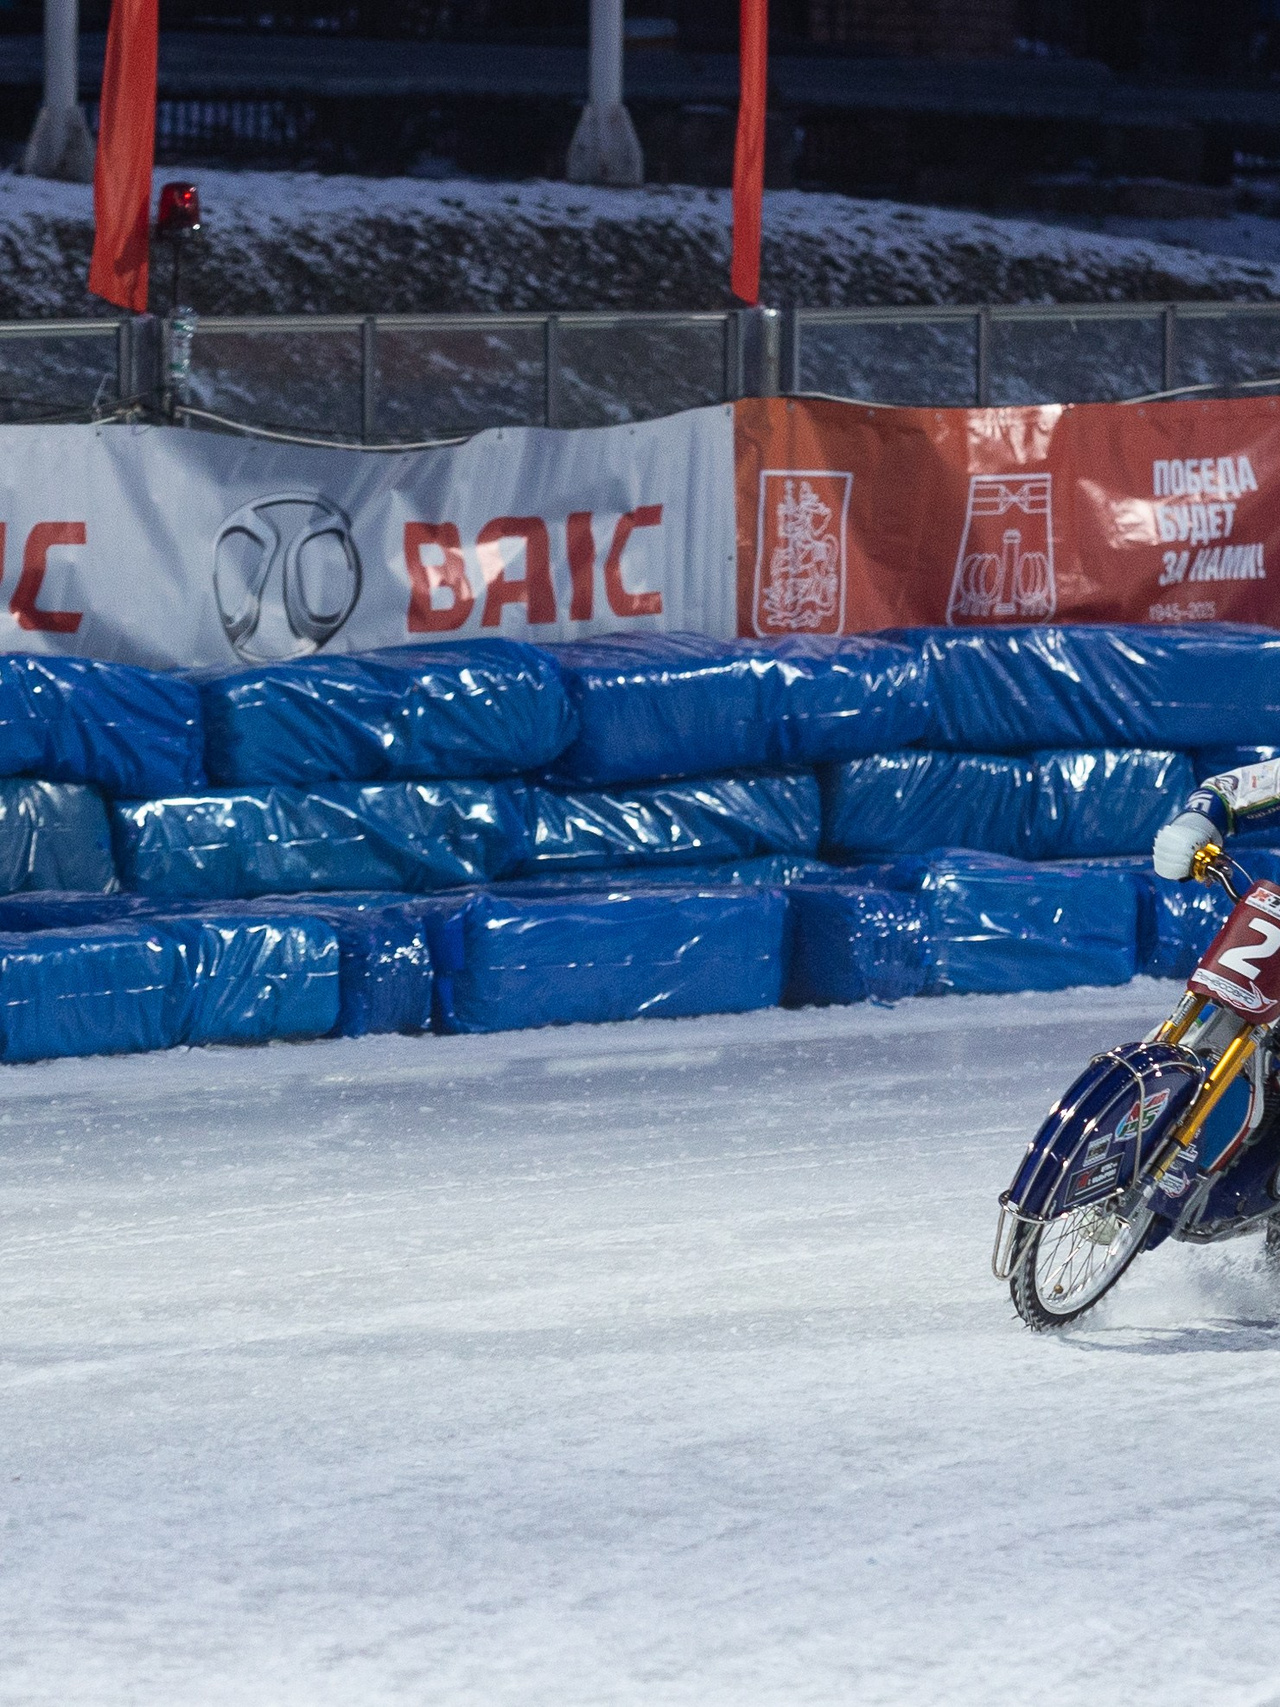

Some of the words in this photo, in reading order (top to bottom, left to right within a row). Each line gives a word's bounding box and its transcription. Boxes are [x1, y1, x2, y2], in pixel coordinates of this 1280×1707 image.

[1153, 455, 1258, 500] ПОБЕДА
[1157, 502, 1237, 547] БУДЕТ
[403, 504, 662, 633] BAIC
